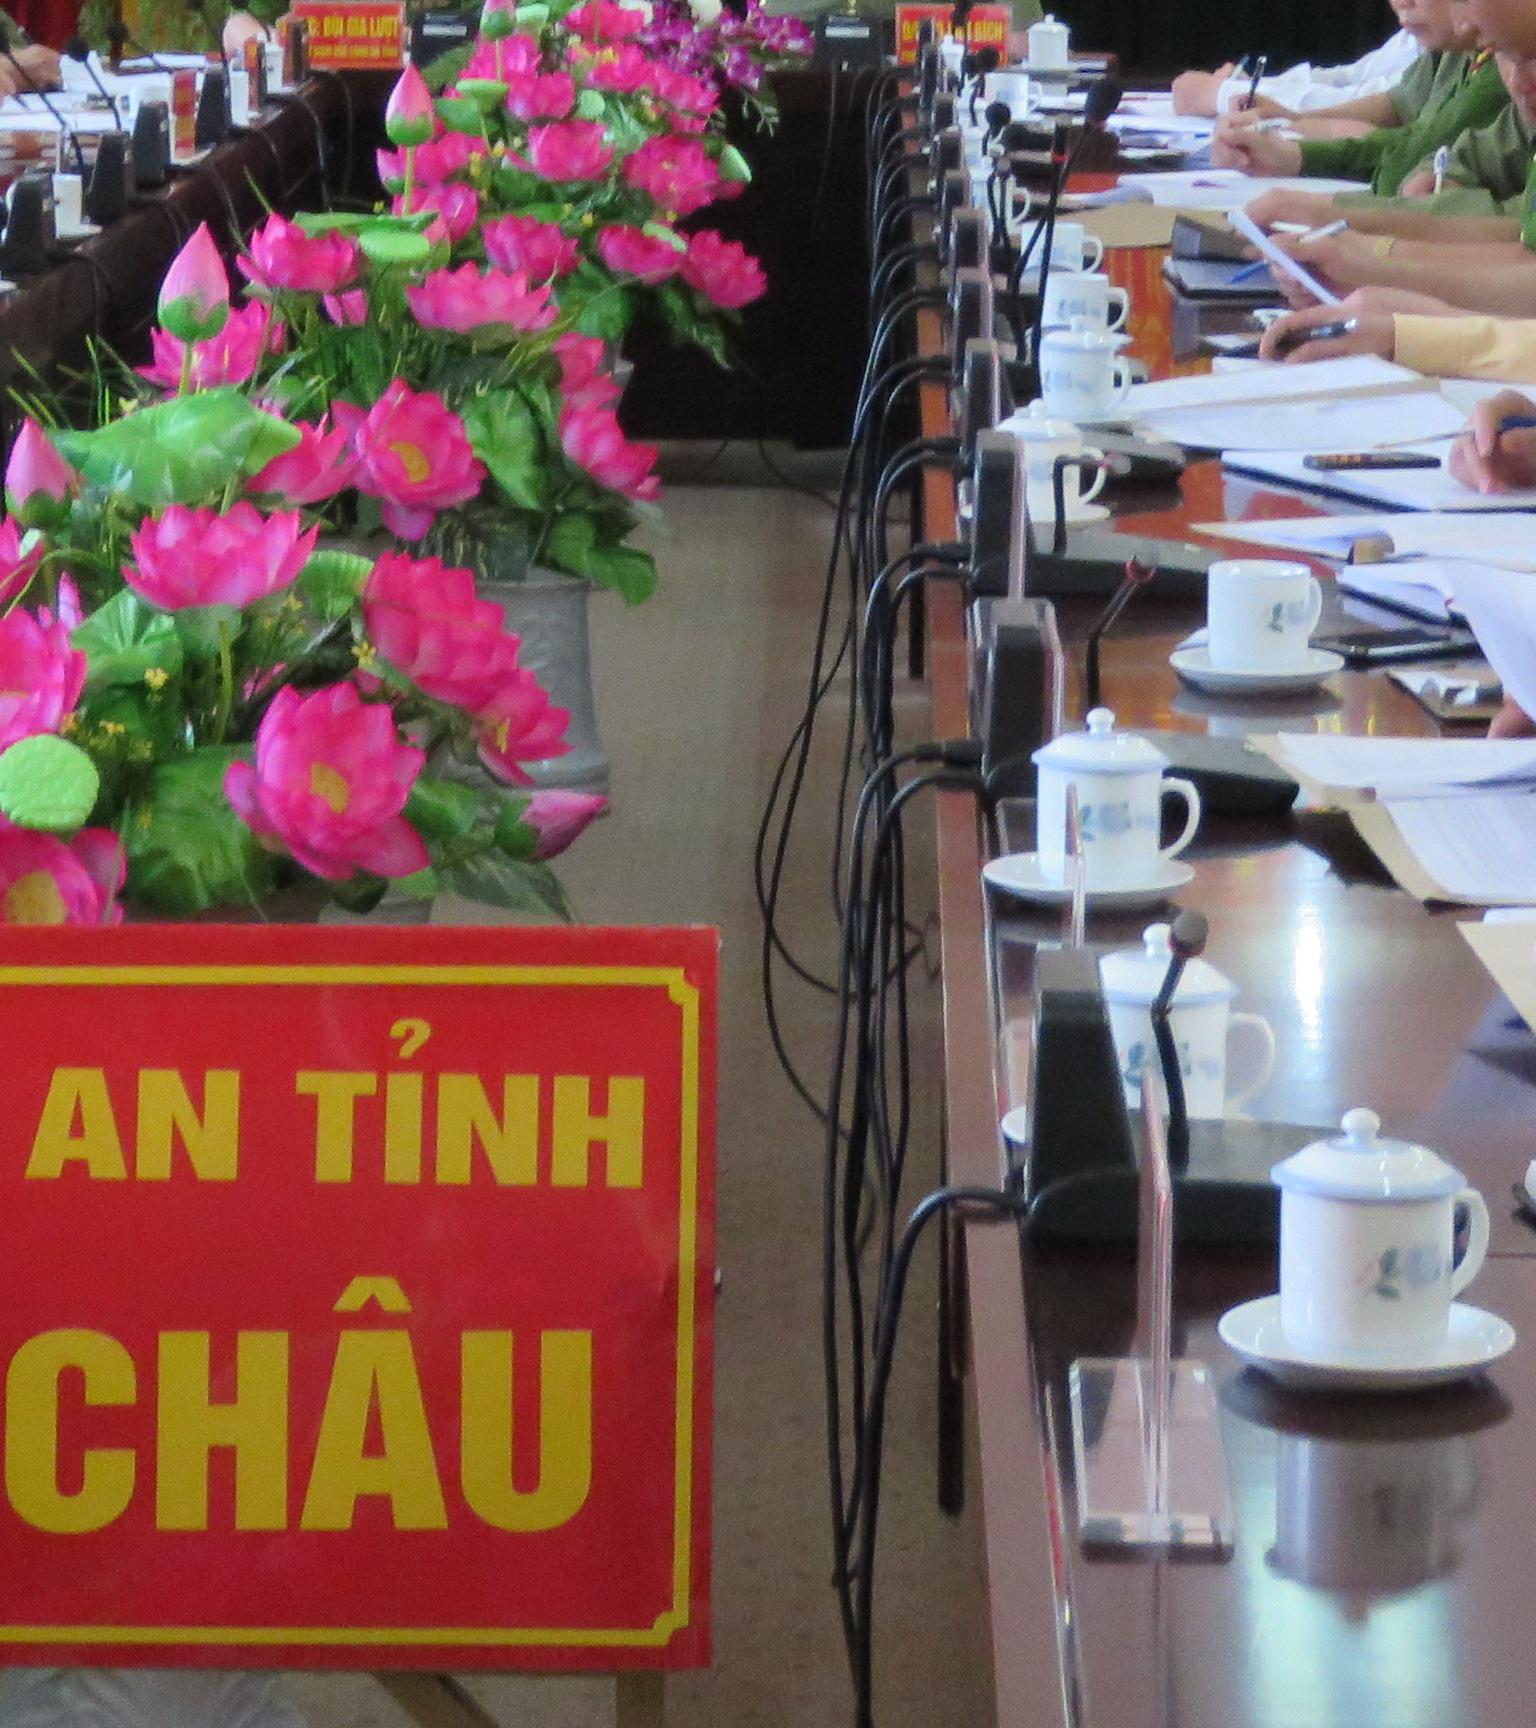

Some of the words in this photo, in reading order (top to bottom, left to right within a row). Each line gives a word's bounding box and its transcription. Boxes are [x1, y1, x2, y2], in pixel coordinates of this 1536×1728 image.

[26, 1068, 240, 1180] AN
[296, 1019, 644, 1188] TỈNH
[6, 1277, 592, 1532] CHÂU
